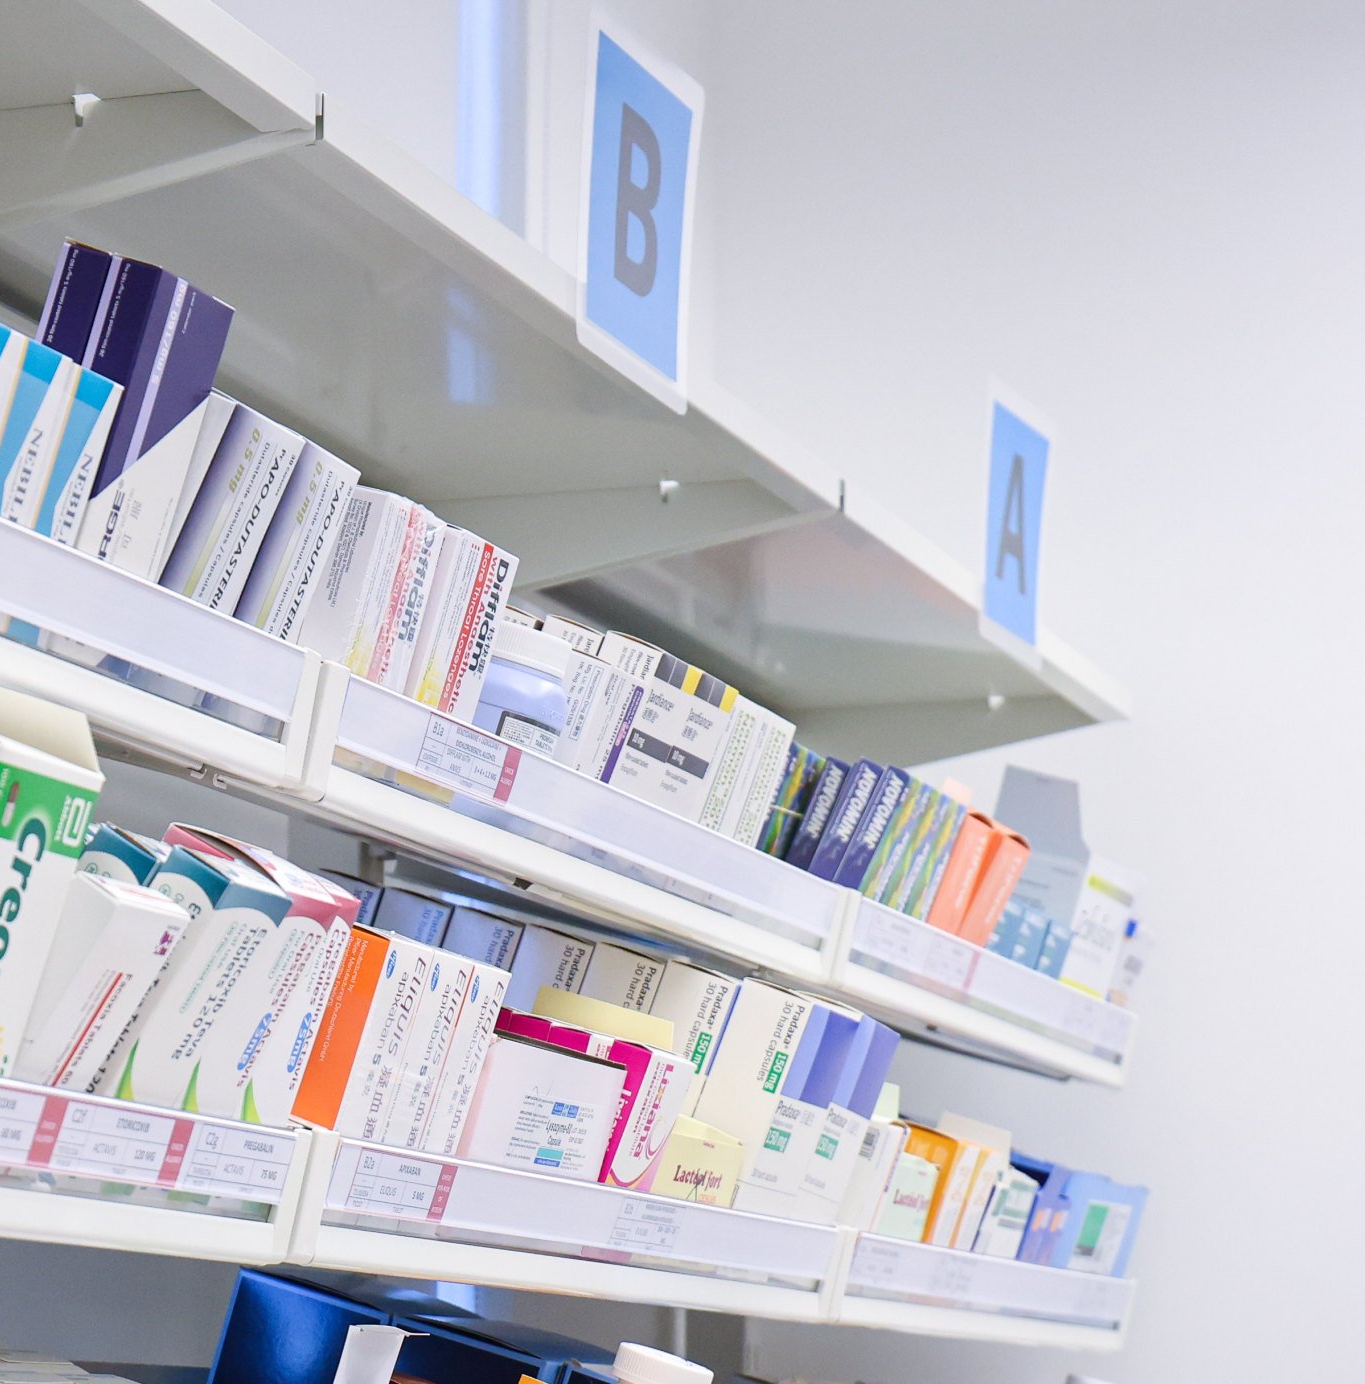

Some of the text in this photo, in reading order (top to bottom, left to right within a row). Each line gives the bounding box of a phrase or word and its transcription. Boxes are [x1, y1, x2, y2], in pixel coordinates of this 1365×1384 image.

[613, 102, 662, 297] B
[229, 428, 261, 493] 0.5 mg
[296, 461, 323, 527] 0.5 mg
[198, 442, 270, 599] Dutasteride Capsules
[995, 453, 1025, 596] A
[272, 580, 292, 623] Capsules
[398, 524, 436, 641] Difflam
[468, 558, 510, 671] Difflam
[443, 550, 490, 699] Sore Throat Lozenges
[447, 557, 498, 713] with Anaesthetic
[432, 722, 444, 736] B1a
[54, 794, 71, 841] Abbott
[185, 928, 268, 1057] Etoricoxib Teva
[193, 926, 261, 1027] Tablets 120
[270, 932, 314, 1006] Capsules
[310, 929, 340, 1005] Capsules
[312, 931, 347, 1023] Pregabalin
[555, 944, 575, 982] 30 hard
[567, 947, 585, 988] Pradaxa
[626, 962, 647, 1001] 30 hard
[639, 967, 657, 1007] Pradaxa
[696, 981, 717, 1019] 30 hard
[236, 934, 323, 1087] Pregabalin Actavis
[372, 971, 410, 1065] apixaban 5
[388, 956, 427, 1056] Eliquis
[419, 983, 452, 1076] apixaban 5
[432, 969, 467, 1065] Eliquis
[456, 995, 490, 1085] apixaban 5
[469, 981, 504, 1074] Eliquis
[699, 986, 728, 1052] Pradaxa 150
[756, 1001, 794, 1081] 30 hard capsules
[70, 1024, 100, 1067] Tablets
[763, 1005, 806, 1091] Pradaxa 150 mg
[243, 1140, 274, 1155] PREGABALIN
[362, 1155, 375, 1170] B2a
[398, 1164, 422, 1176] APIXABAN
[673, 1164, 723, 1190] Lactéol fort
[379, 1185, 416, 1200] ELIQUIS 5
